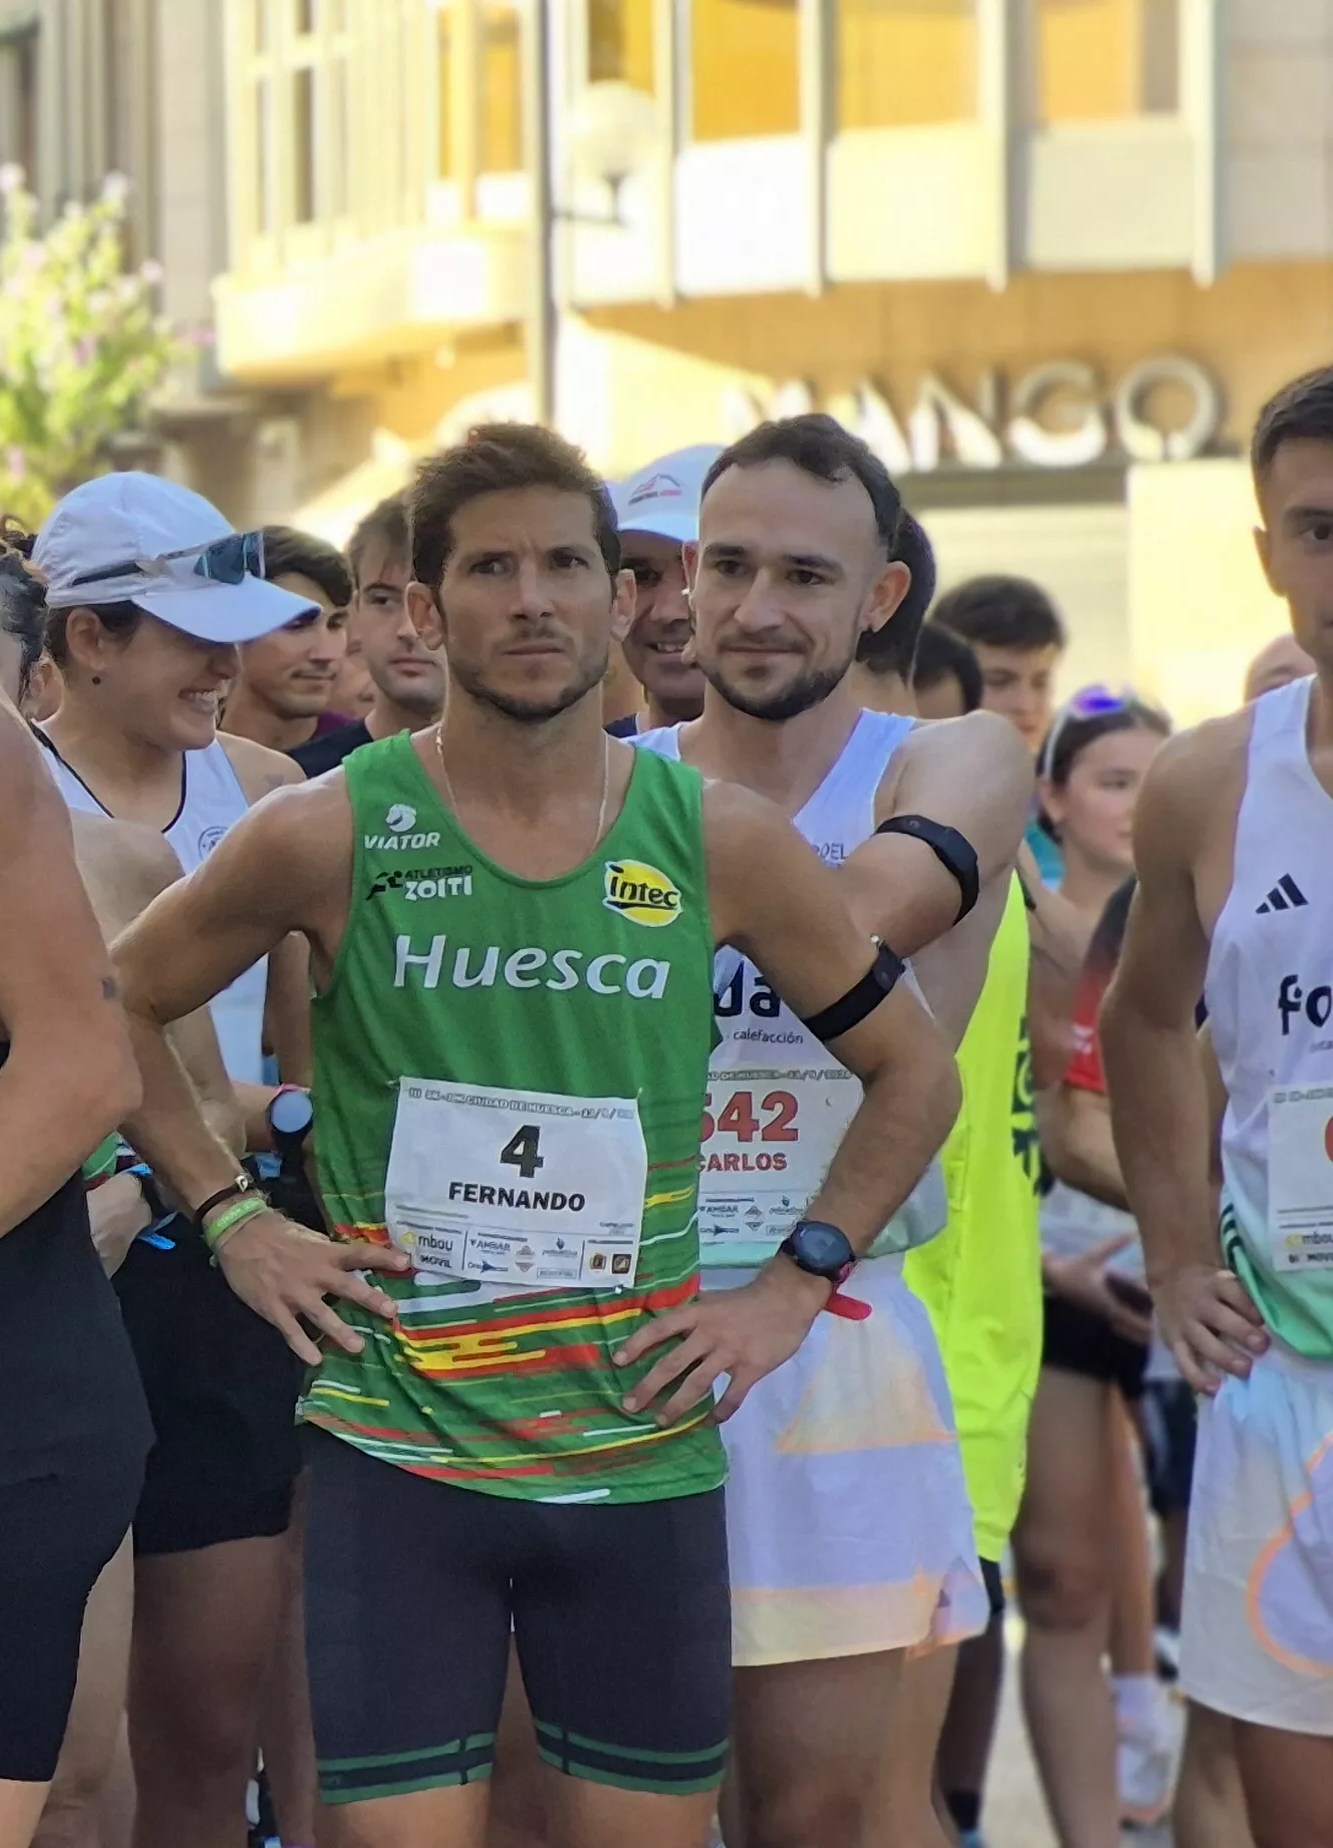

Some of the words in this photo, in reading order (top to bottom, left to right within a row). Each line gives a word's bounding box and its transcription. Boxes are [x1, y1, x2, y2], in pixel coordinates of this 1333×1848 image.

[718, 357, 1217, 474] MANGO
[364, 832, 441, 851] VIATOR
[404, 876, 473, 901] ZOITI
[608, 864, 680, 908] intec
[393, 934, 671, 999] Huesca
[733, 1027, 804, 1044] calefacción
[500, 1124, 544, 1179] 4
[448, 1181, 586, 1212] FERNANDO
